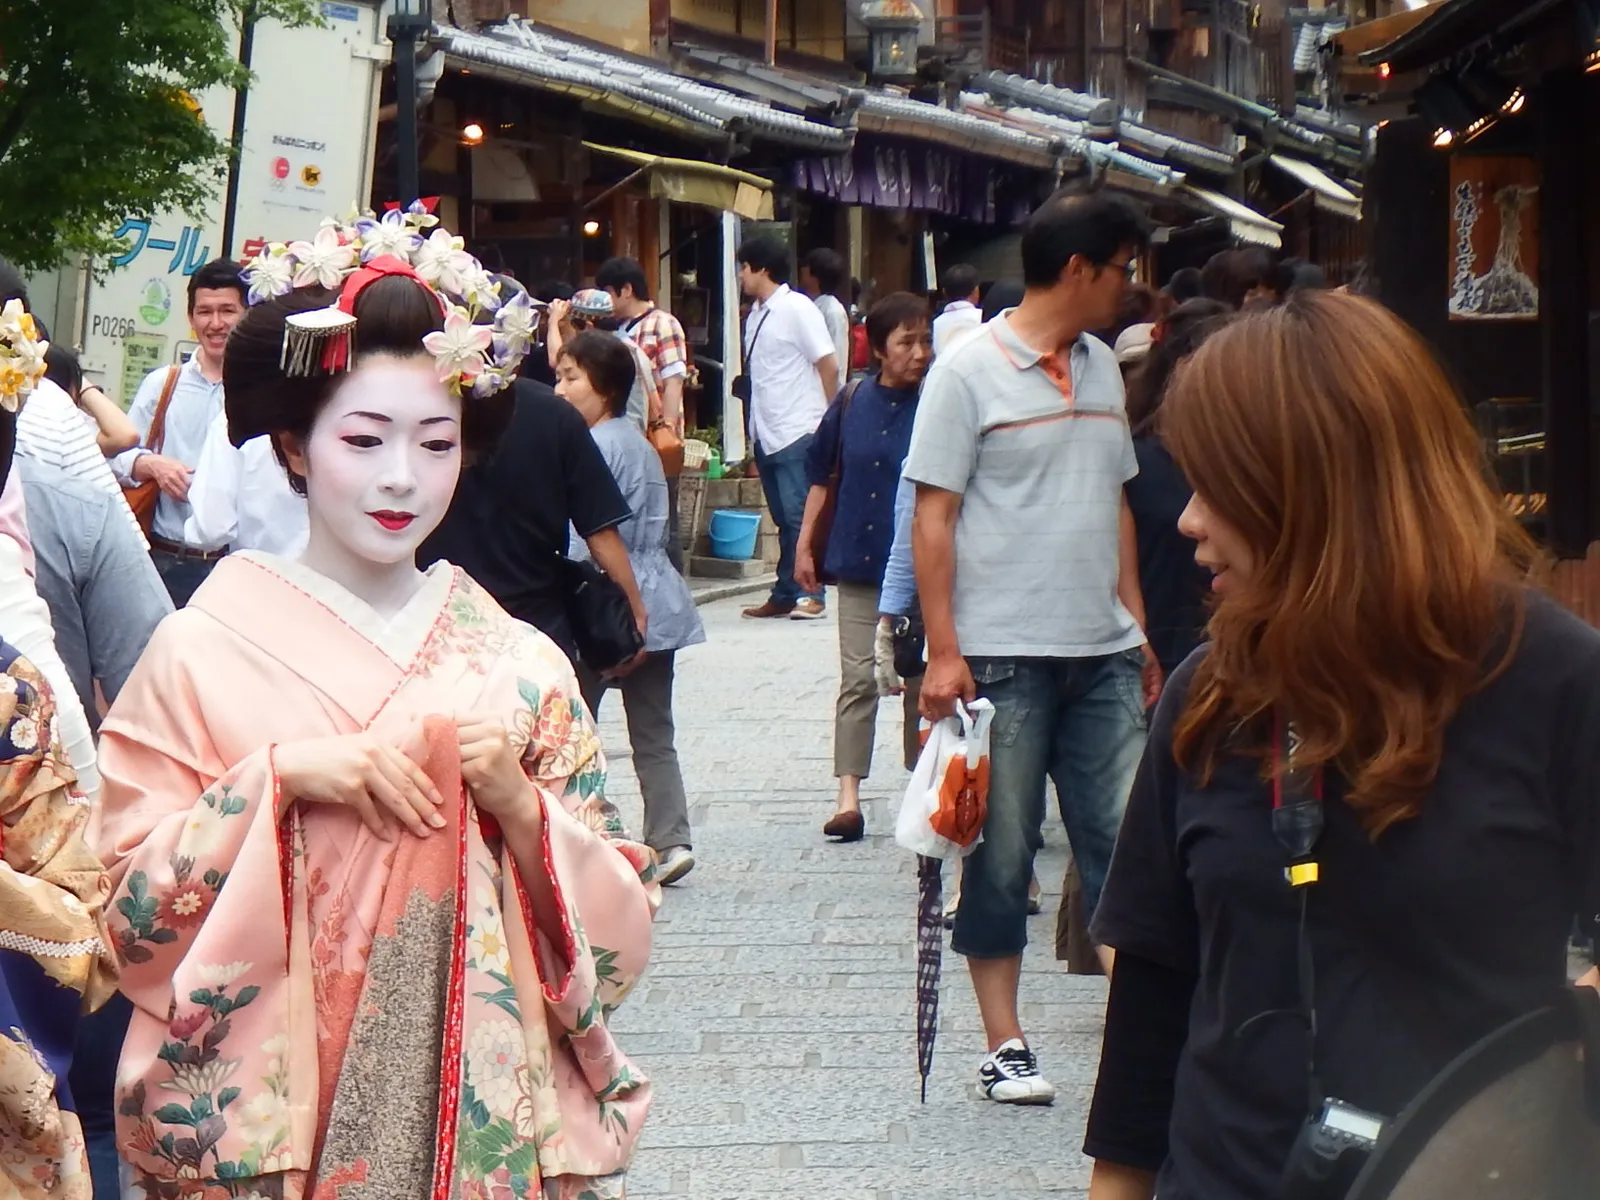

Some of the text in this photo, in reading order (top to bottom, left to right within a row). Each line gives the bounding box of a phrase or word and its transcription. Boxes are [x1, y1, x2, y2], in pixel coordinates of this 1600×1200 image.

[114, 218, 210, 276] クール
[92, 314, 136, 339] P0266
